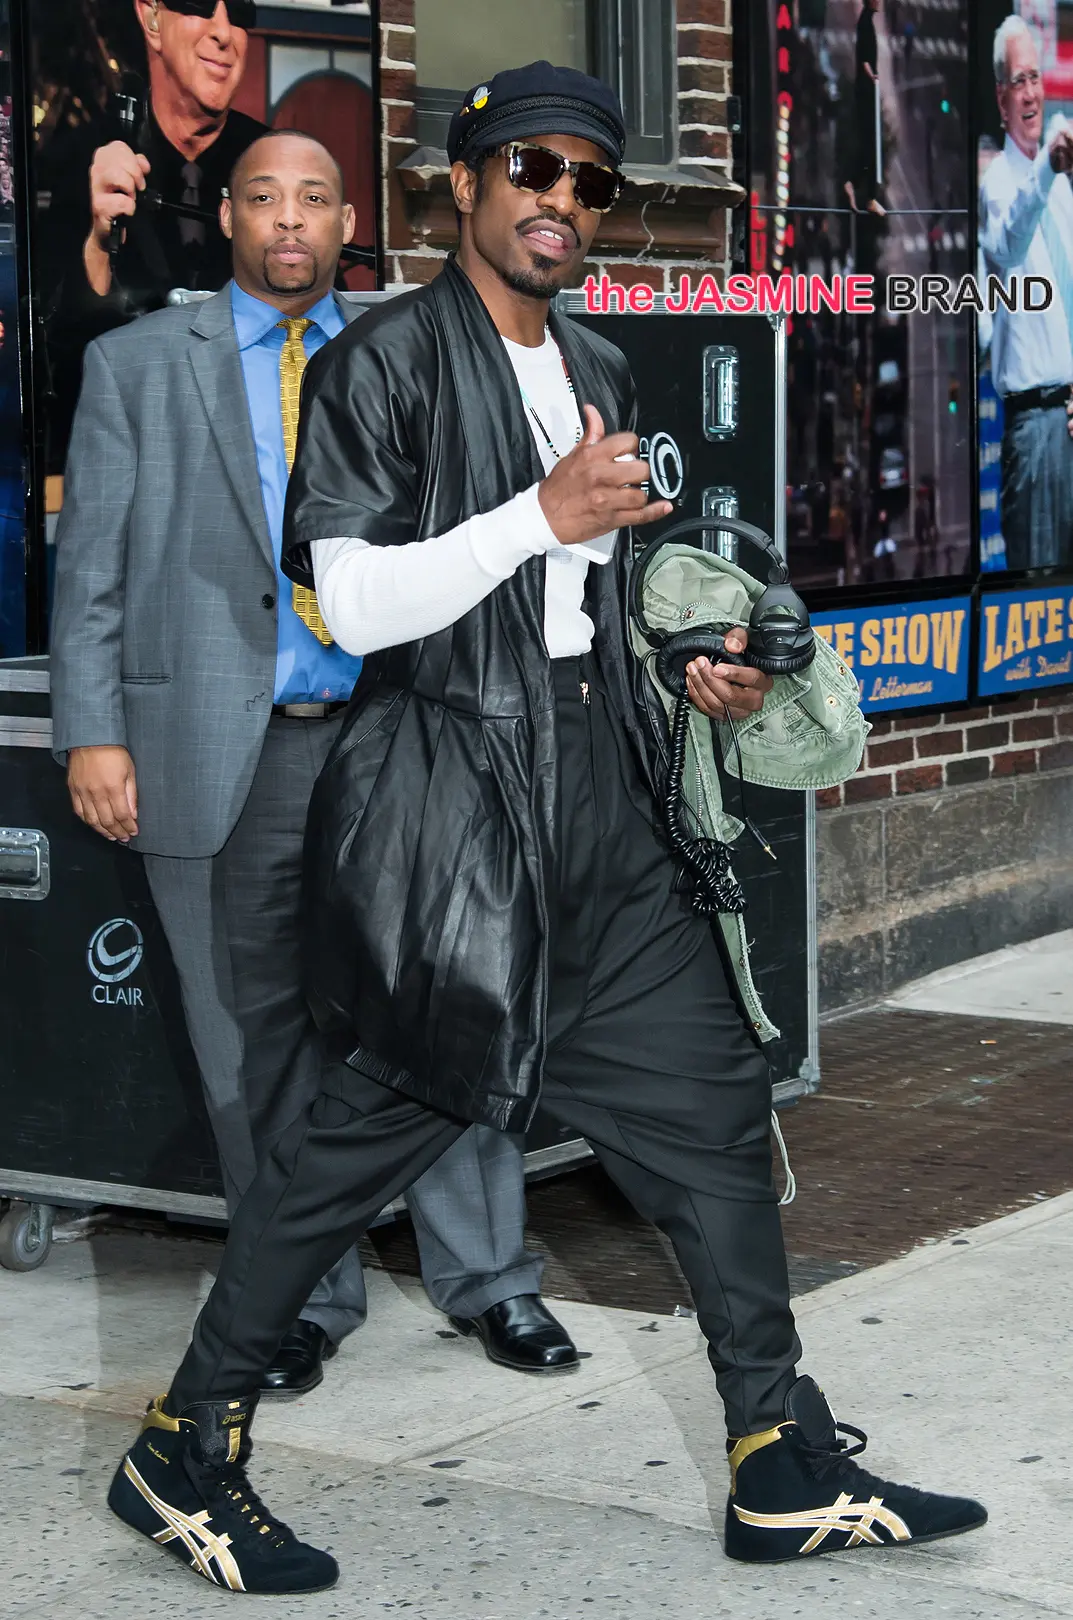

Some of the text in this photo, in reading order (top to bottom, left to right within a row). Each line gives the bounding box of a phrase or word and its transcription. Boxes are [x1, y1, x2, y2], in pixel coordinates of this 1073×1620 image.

[860, 609, 966, 675] SHOW
[983, 598, 1064, 673] LATE
[1035, 650, 1072, 677] David
[868, 676, 933, 701] Letterman
[92, 984, 144, 1007] CLAIR
